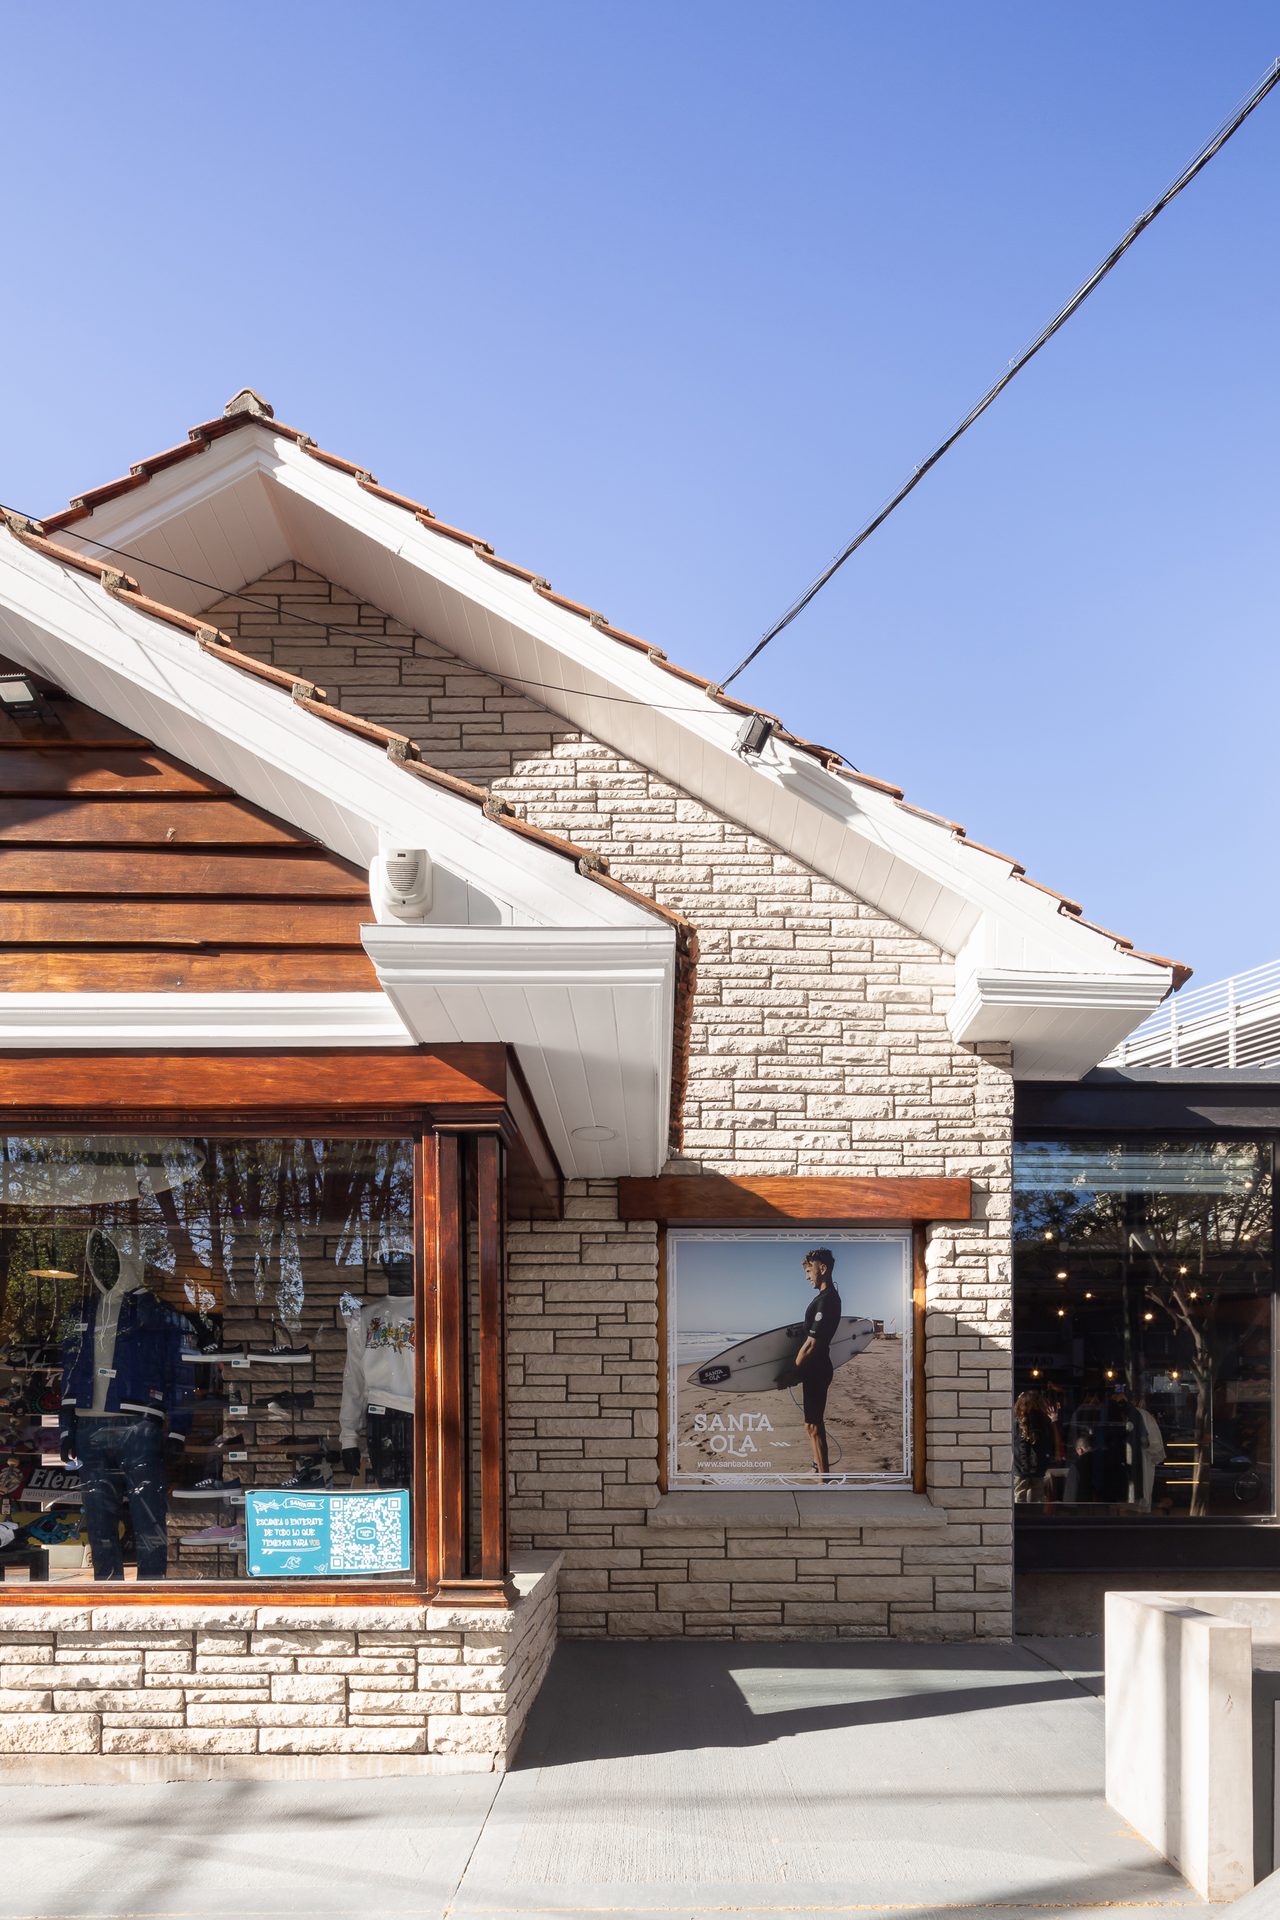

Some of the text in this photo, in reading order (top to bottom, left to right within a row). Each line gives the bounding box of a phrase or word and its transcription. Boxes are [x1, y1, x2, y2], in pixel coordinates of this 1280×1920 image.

[705, 1369, 724, 1377] SANTA
[694, 1412, 774, 1432] SANTA
[709, 1434, 758, 1458] OLA
[697, 1460, 772, 1469] www.santaola.com
[301, 1528, 316, 1536] QUE
